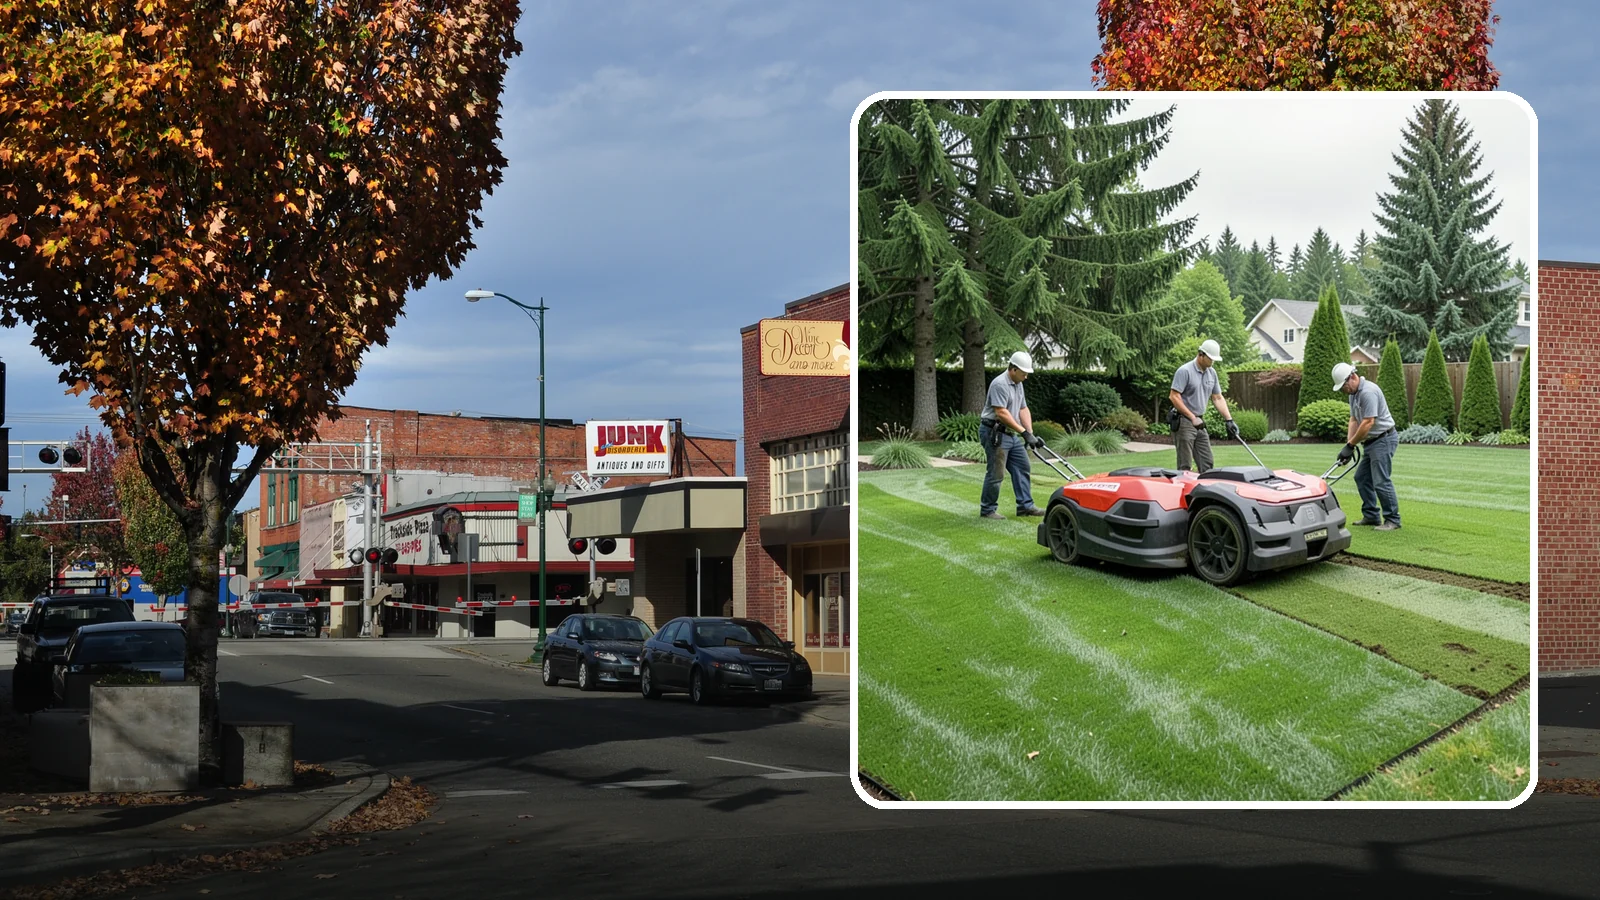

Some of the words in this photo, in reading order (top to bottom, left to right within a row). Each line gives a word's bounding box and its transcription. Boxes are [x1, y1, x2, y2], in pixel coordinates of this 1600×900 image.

[595, 425, 664, 457] JUNK
[607, 446, 645, 454] DISORDERLY
[597, 461, 628, 470] ANTIQUES
[631, 461, 644, 470] AND
[647, 460, 665, 469] GIFTS
[414, 519, 429, 535] Pizza
